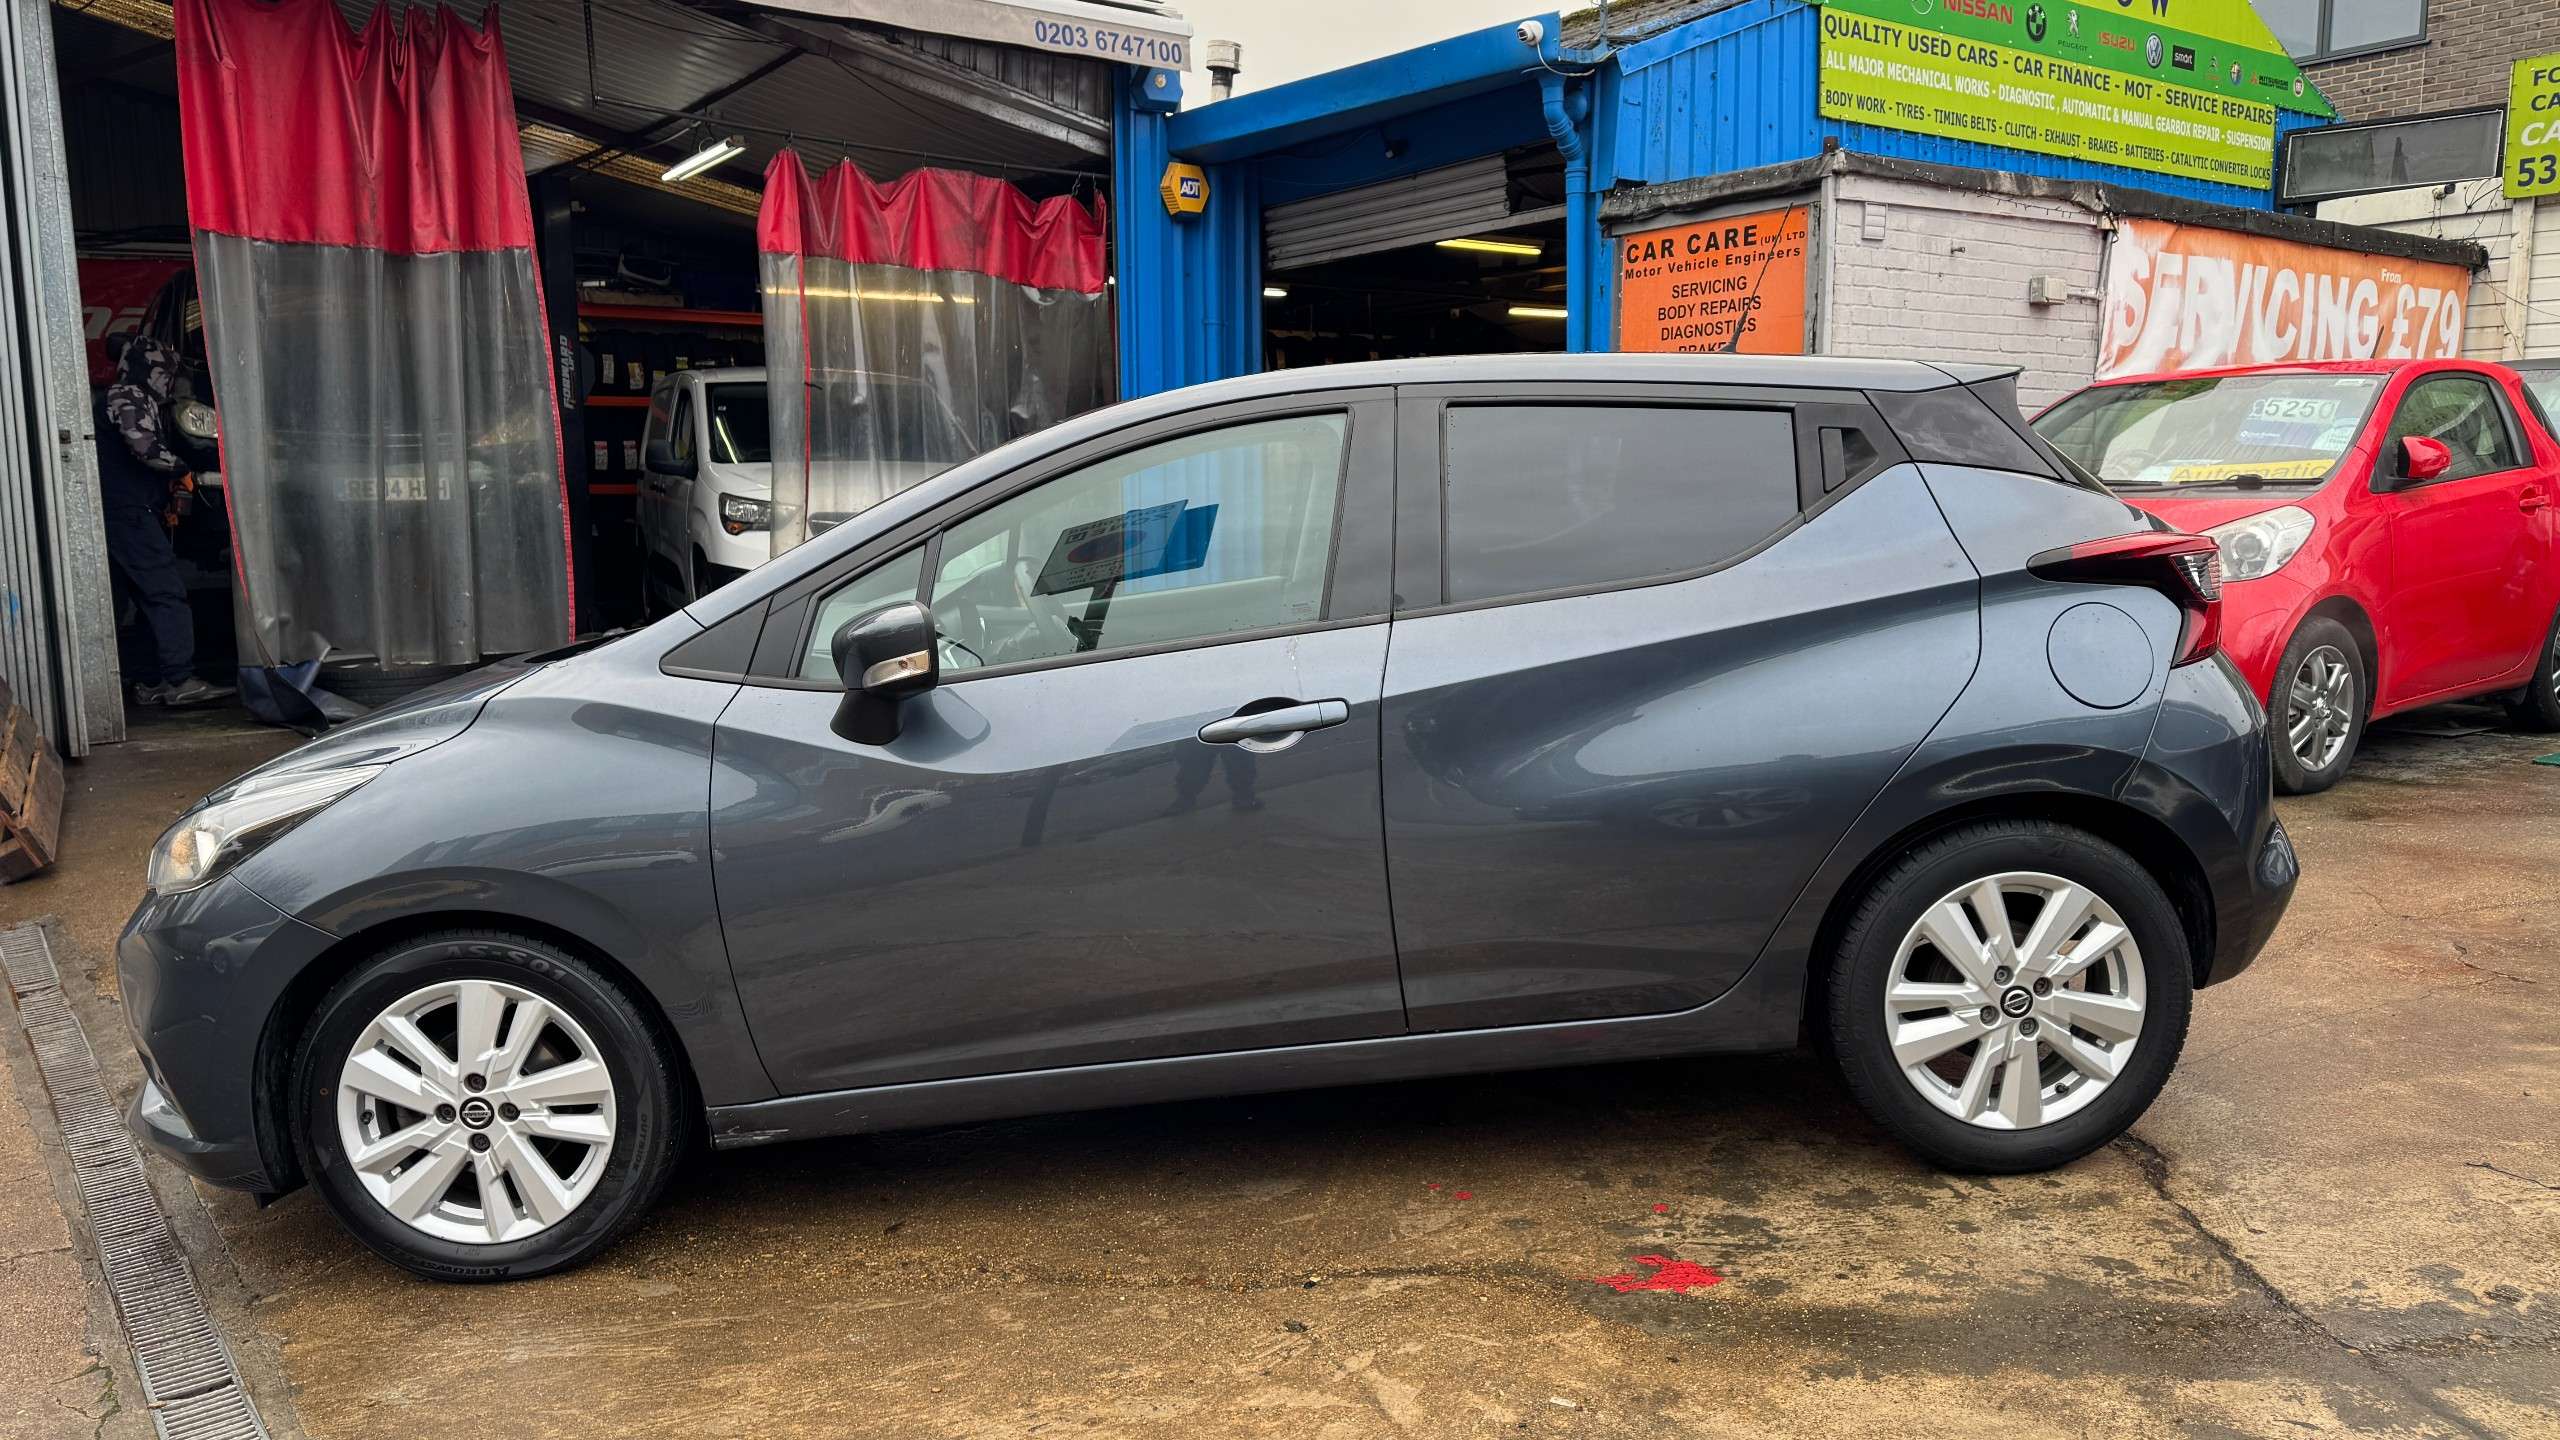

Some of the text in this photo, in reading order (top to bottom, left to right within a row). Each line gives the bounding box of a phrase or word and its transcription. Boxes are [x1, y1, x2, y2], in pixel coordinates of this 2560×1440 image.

[1035, 20, 1183, 64] 0203 6747100
[2174, 52, 2192, 65] smart
[1824, 14, 1902, 48] QUALITY
[1908, 32, 1951, 58] USED
[1957, 43, 1998, 68] CARS
[2014, 55, 2043, 77] CAR
[2049, 62, 2110, 91] FINANCE
[2125, 79, 2152, 100] MOT
[2165, 88, 2218, 119] SERVICE
[2222, 102, 2273, 125] REPAIRS
[1826, 50, 1846, 70] ALL
[1849, 55, 1885, 78] MAJOR
[1888, 63, 1952, 91] MECHANICAL
[1955, 75, 1990, 97] WORKS
[1999, 84, 2055, 110] DIAGNOSTIC
[2062, 97, 2111, 121] AUTOMATIC
[2113, 108, 2119, 123] &
[2121, 109, 2154, 130] MANUAL
[2156, 116, 2191, 137] GEARBOX
[2193, 123, 2220, 142] REPAIR
[2226, 130, 2272, 151] SUSPENSION
[1825, 89, 1853, 107] BODY
[1856, 96, 1886, 114] WORK
[1896, 101, 1925, 121] TYRES
[1934, 108, 1968, 128] TIMING
[1971, 115, 1997, 133] BELTS
[2005, 121, 2037, 140] CLUTCH
[2045, 128, 2081, 148] EXHAUST
[2088, 137, 2118, 154] BRAKES
[2125, 143, 2164, 162] BATTERIES
[2170, 152, 2209, 170] CATALYTIC
[2210, 160, 2249, 176] CONVERTER
[2250, 164, 2271, 181] LOCKS
[1181, 181, 1201, 196] ADT
[1626, 238, 1675, 264] CAR
[1687, 224, 1757, 250] CARE
[1786, 230, 1805, 241] LTD
[1625, 247, 1801, 280] Motor Vehicle Engineers
[2381, 268, 2402, 284] From
[1672, 275, 1747, 299] SERVICING
[1658, 295, 1762, 321] BODY REPAIRS
[2109, 240, 2461, 372] SERVICING £79
